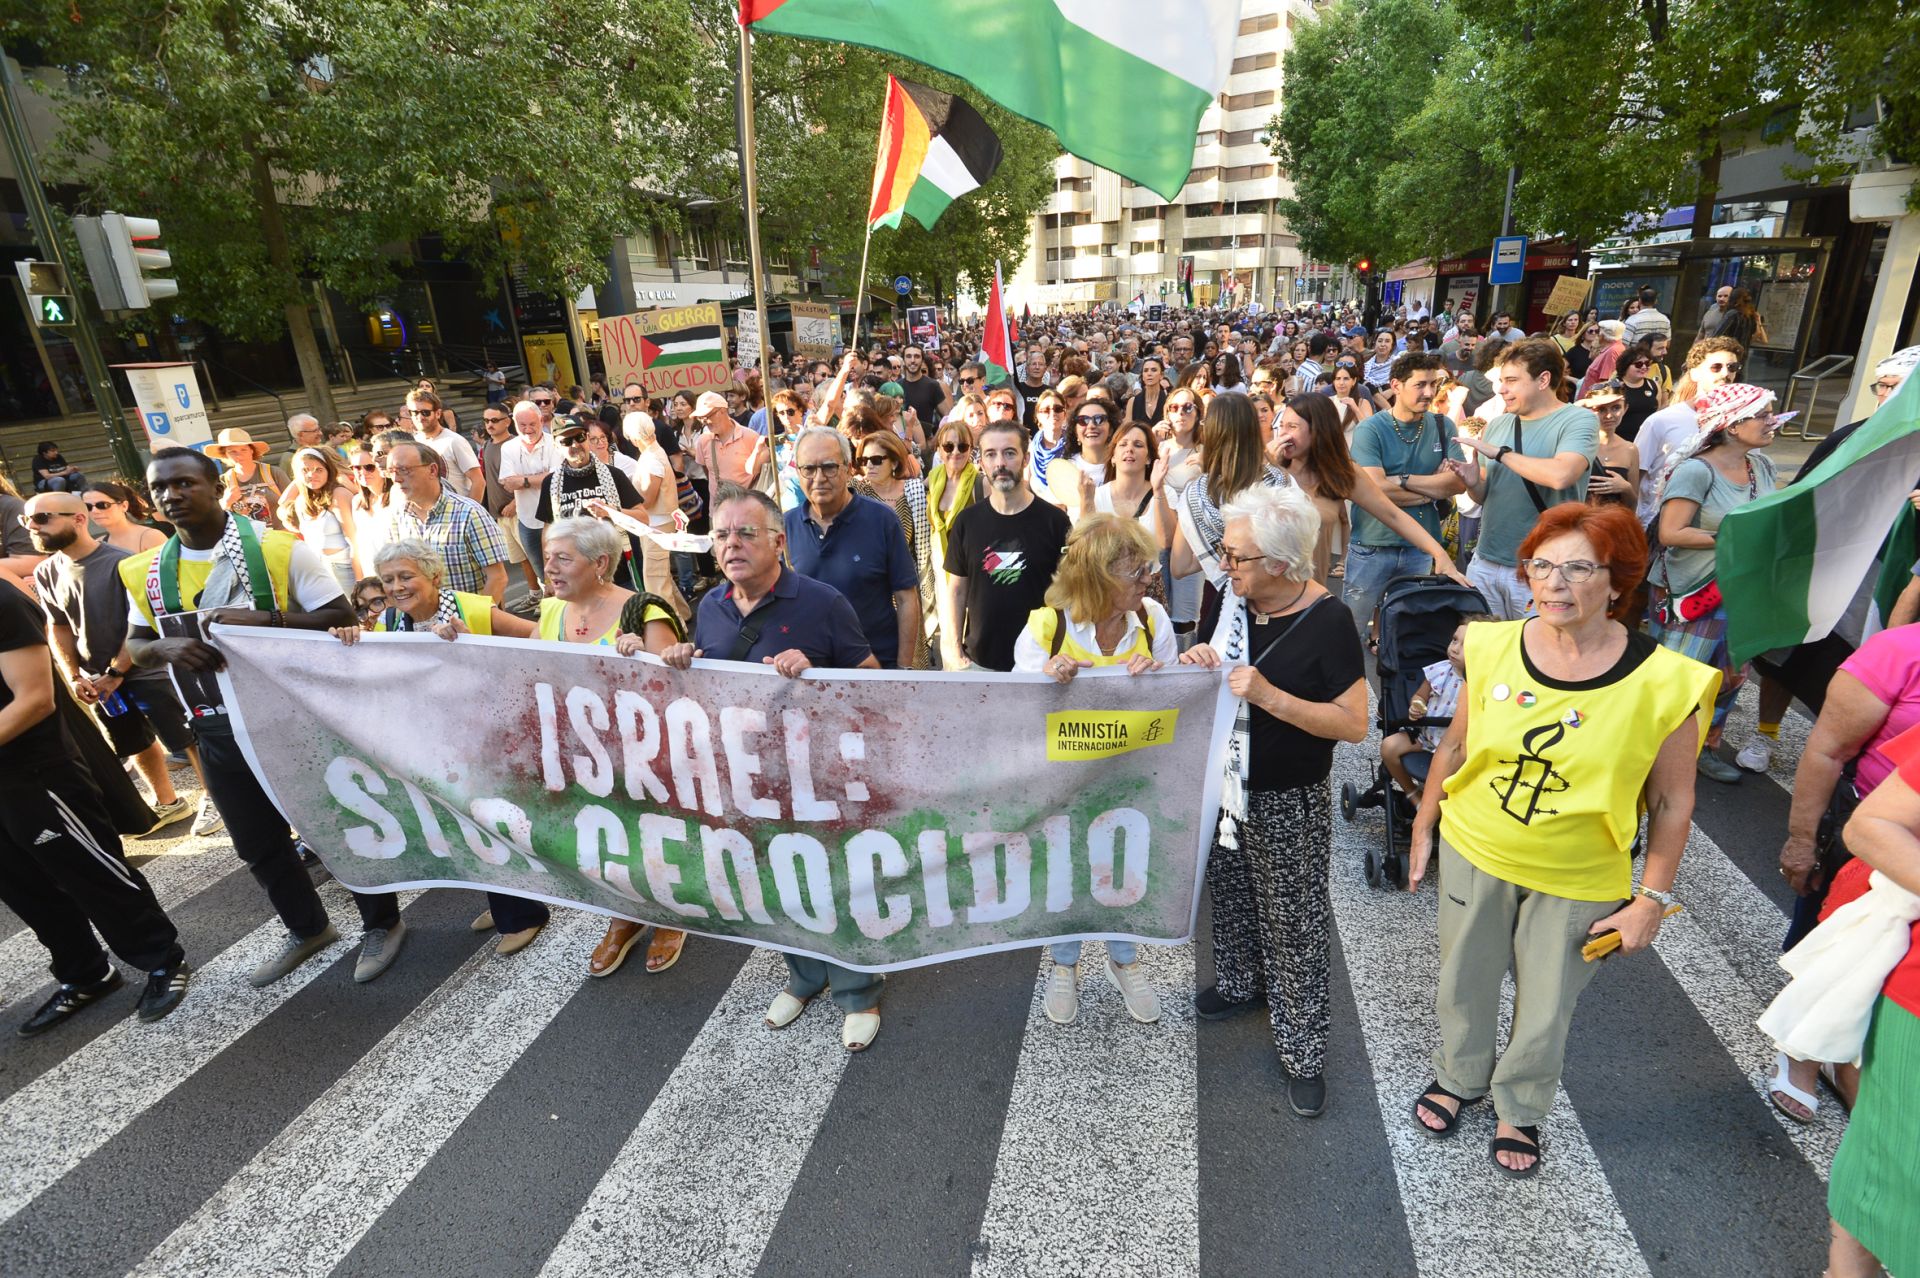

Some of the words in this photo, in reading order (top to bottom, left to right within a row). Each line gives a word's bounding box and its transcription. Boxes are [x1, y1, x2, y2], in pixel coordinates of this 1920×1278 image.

[634, 313, 648, 325] ES
[659, 306, 718, 331] GUERRA
[603, 316, 639, 368] NO
[798, 336, 830, 346] RESISTE
[1058, 720, 1129, 739] AMNISTÍA
[534, 682, 871, 822] ISRAEL:
[1058, 740, 1129, 752] INTERNACIONAL
[573, 806, 1151, 941] GENOCIDIO
